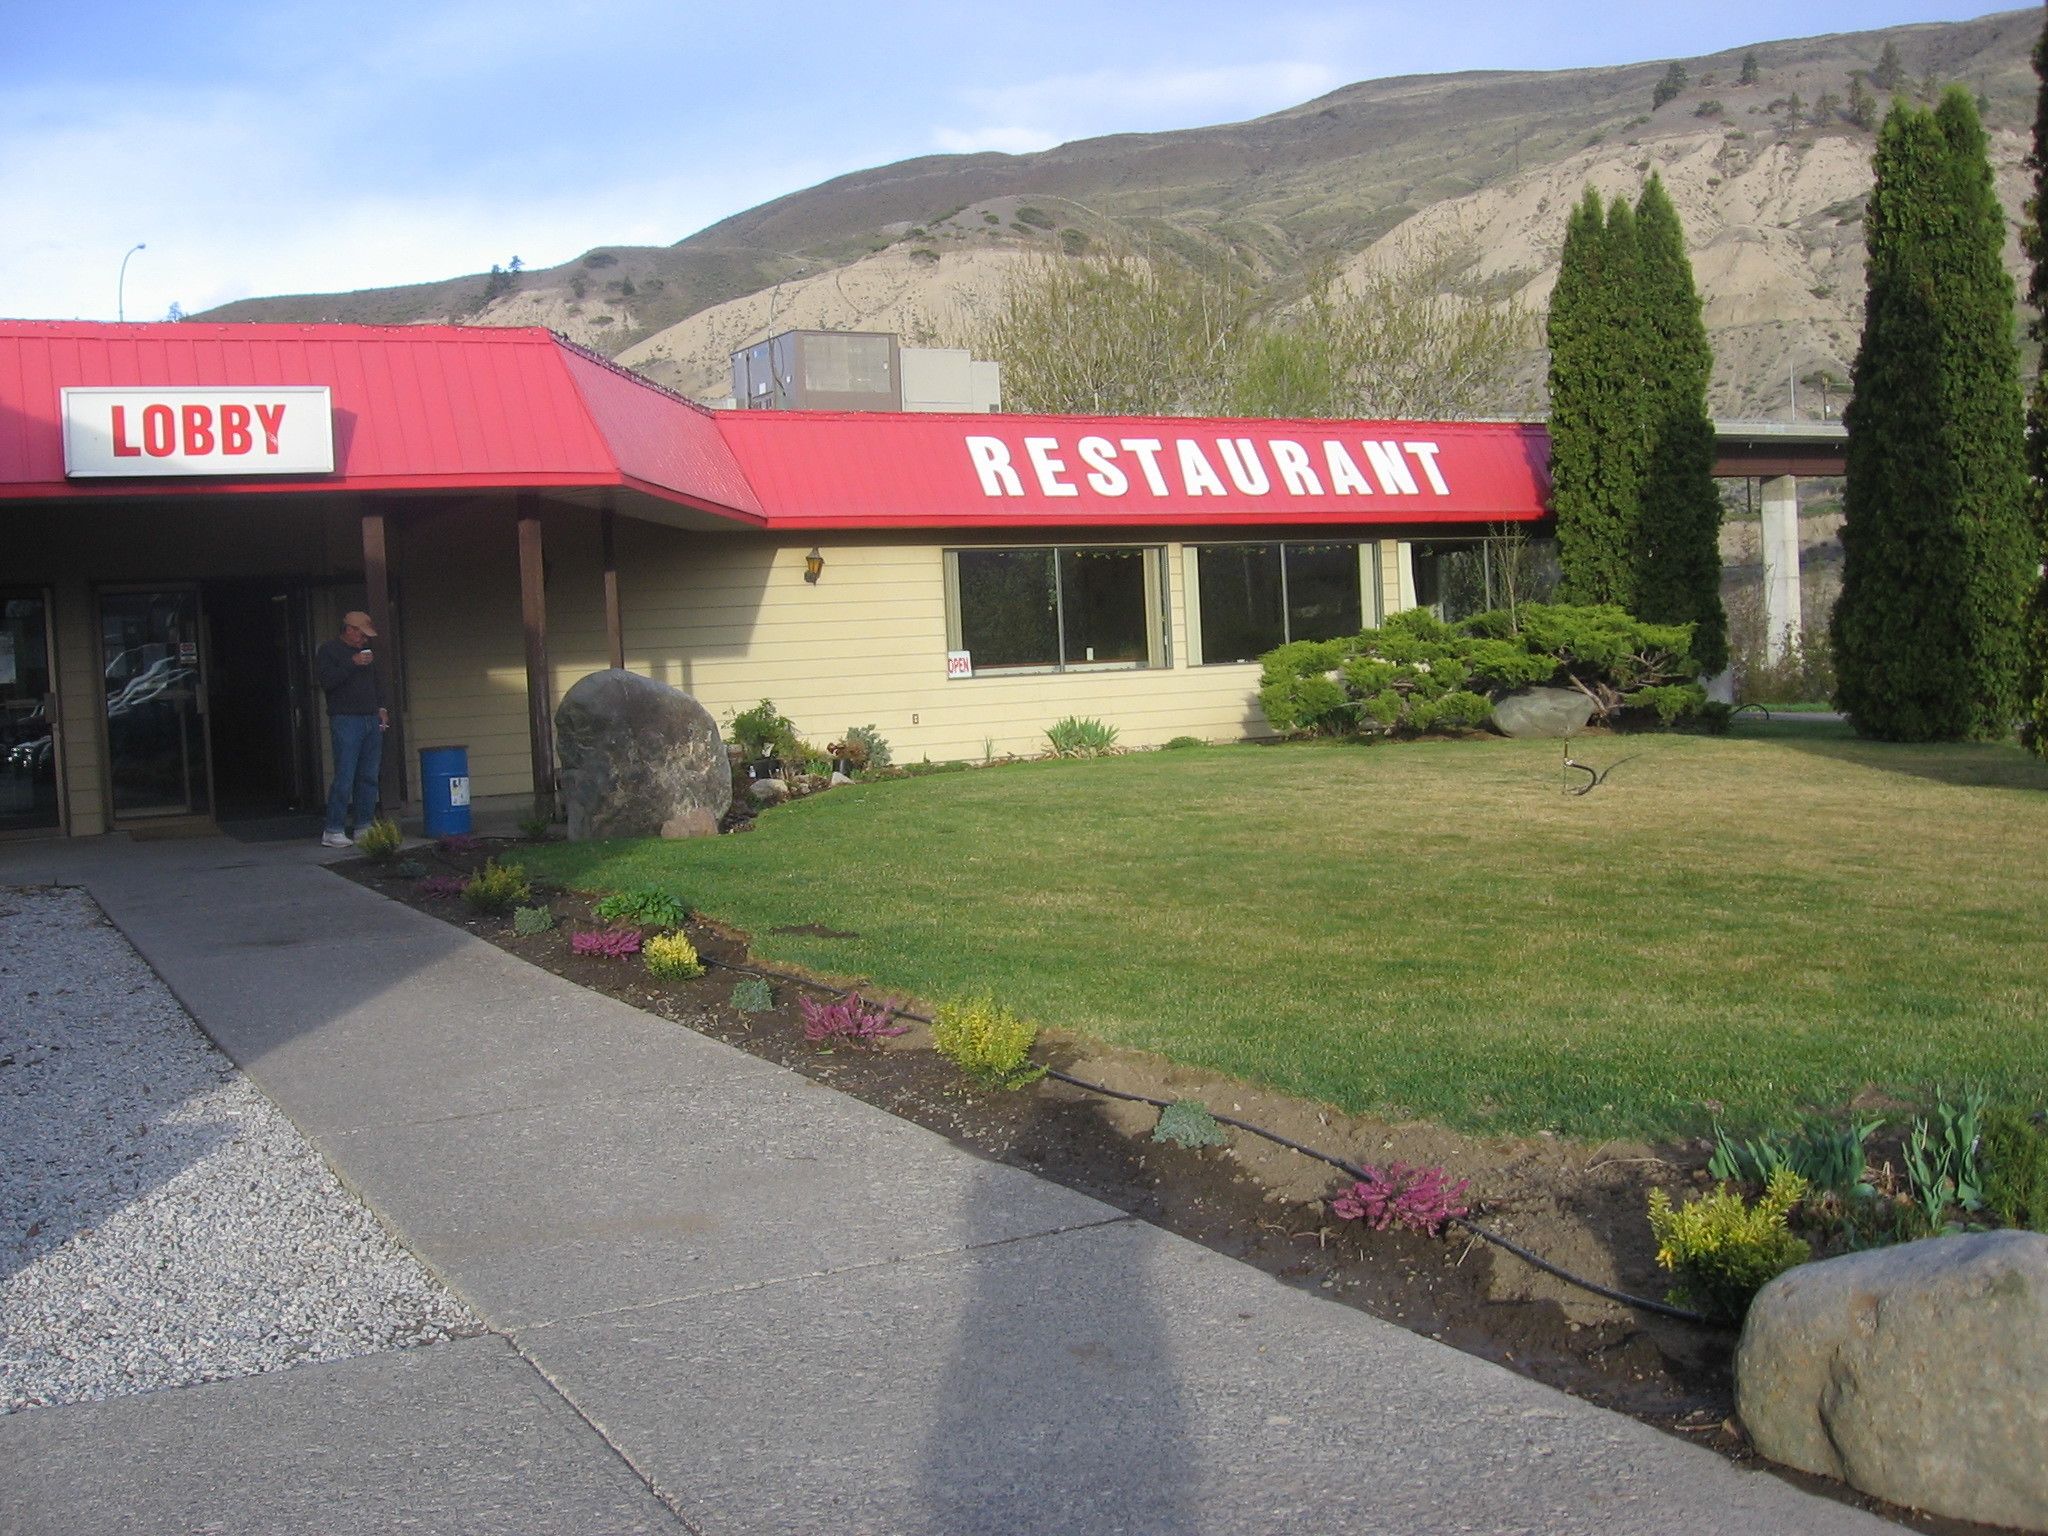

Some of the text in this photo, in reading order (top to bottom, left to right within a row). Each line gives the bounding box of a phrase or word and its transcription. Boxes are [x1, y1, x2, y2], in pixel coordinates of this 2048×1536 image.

[111, 404, 286, 457] LOBBY
[964, 436, 1451, 497] RESTAURANT
[948, 657, 970, 673] OPEN
